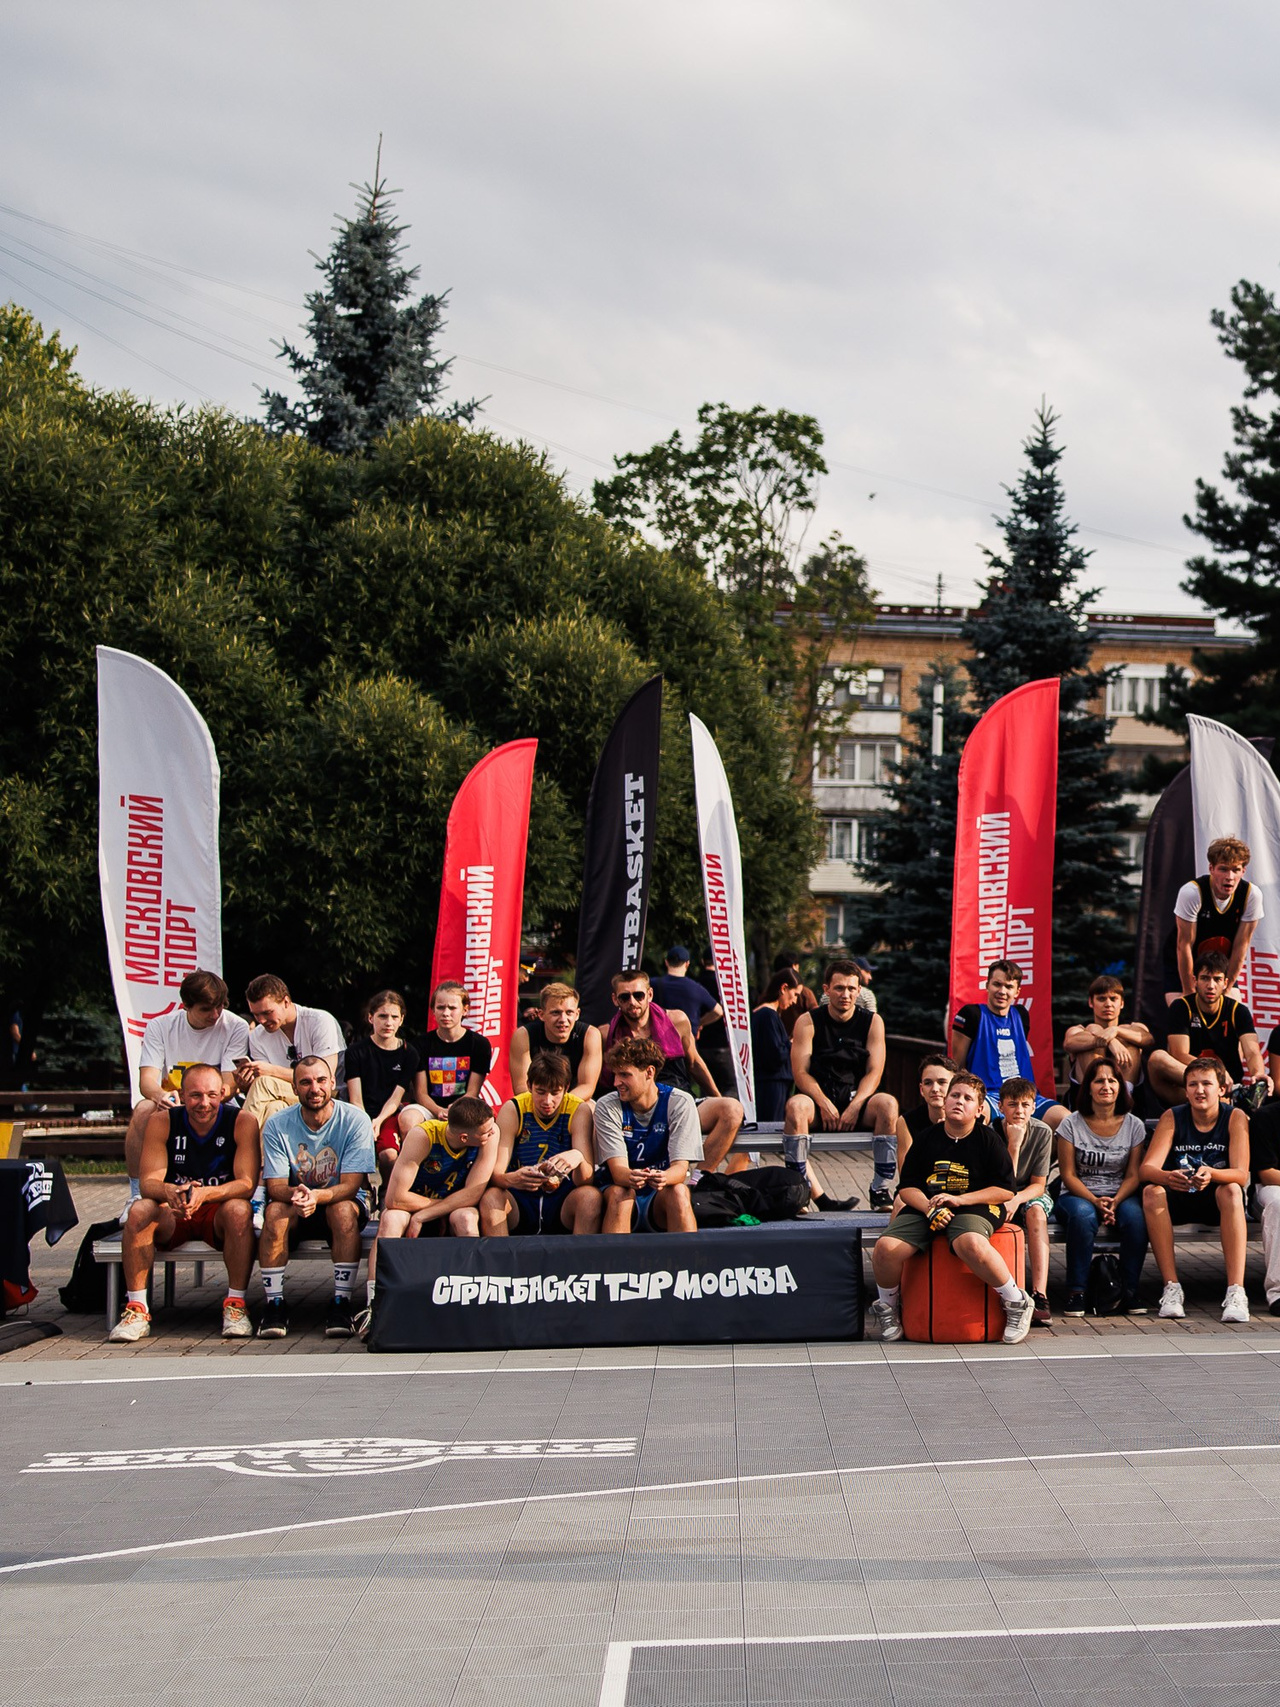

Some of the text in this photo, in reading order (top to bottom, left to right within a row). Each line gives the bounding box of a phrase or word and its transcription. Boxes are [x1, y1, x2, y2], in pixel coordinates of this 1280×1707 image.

[120, 794, 164, 986] МОСКОВСКИЙ
[163, 899, 198, 988] СПОРТ
[482, 956, 504, 1037] СПОРТ
[174, 1135, 188, 1150] 11
[538, 1143, 549, 1164] 7
[636, 1142, 645, 1162] 2
[444, 1171, 458, 1191] 4
[432, 1264, 799, 1306] СТРИТБАСКЕТ ТУР МОСКВА
[28, 1443, 637, 1469] STREETBASKET
